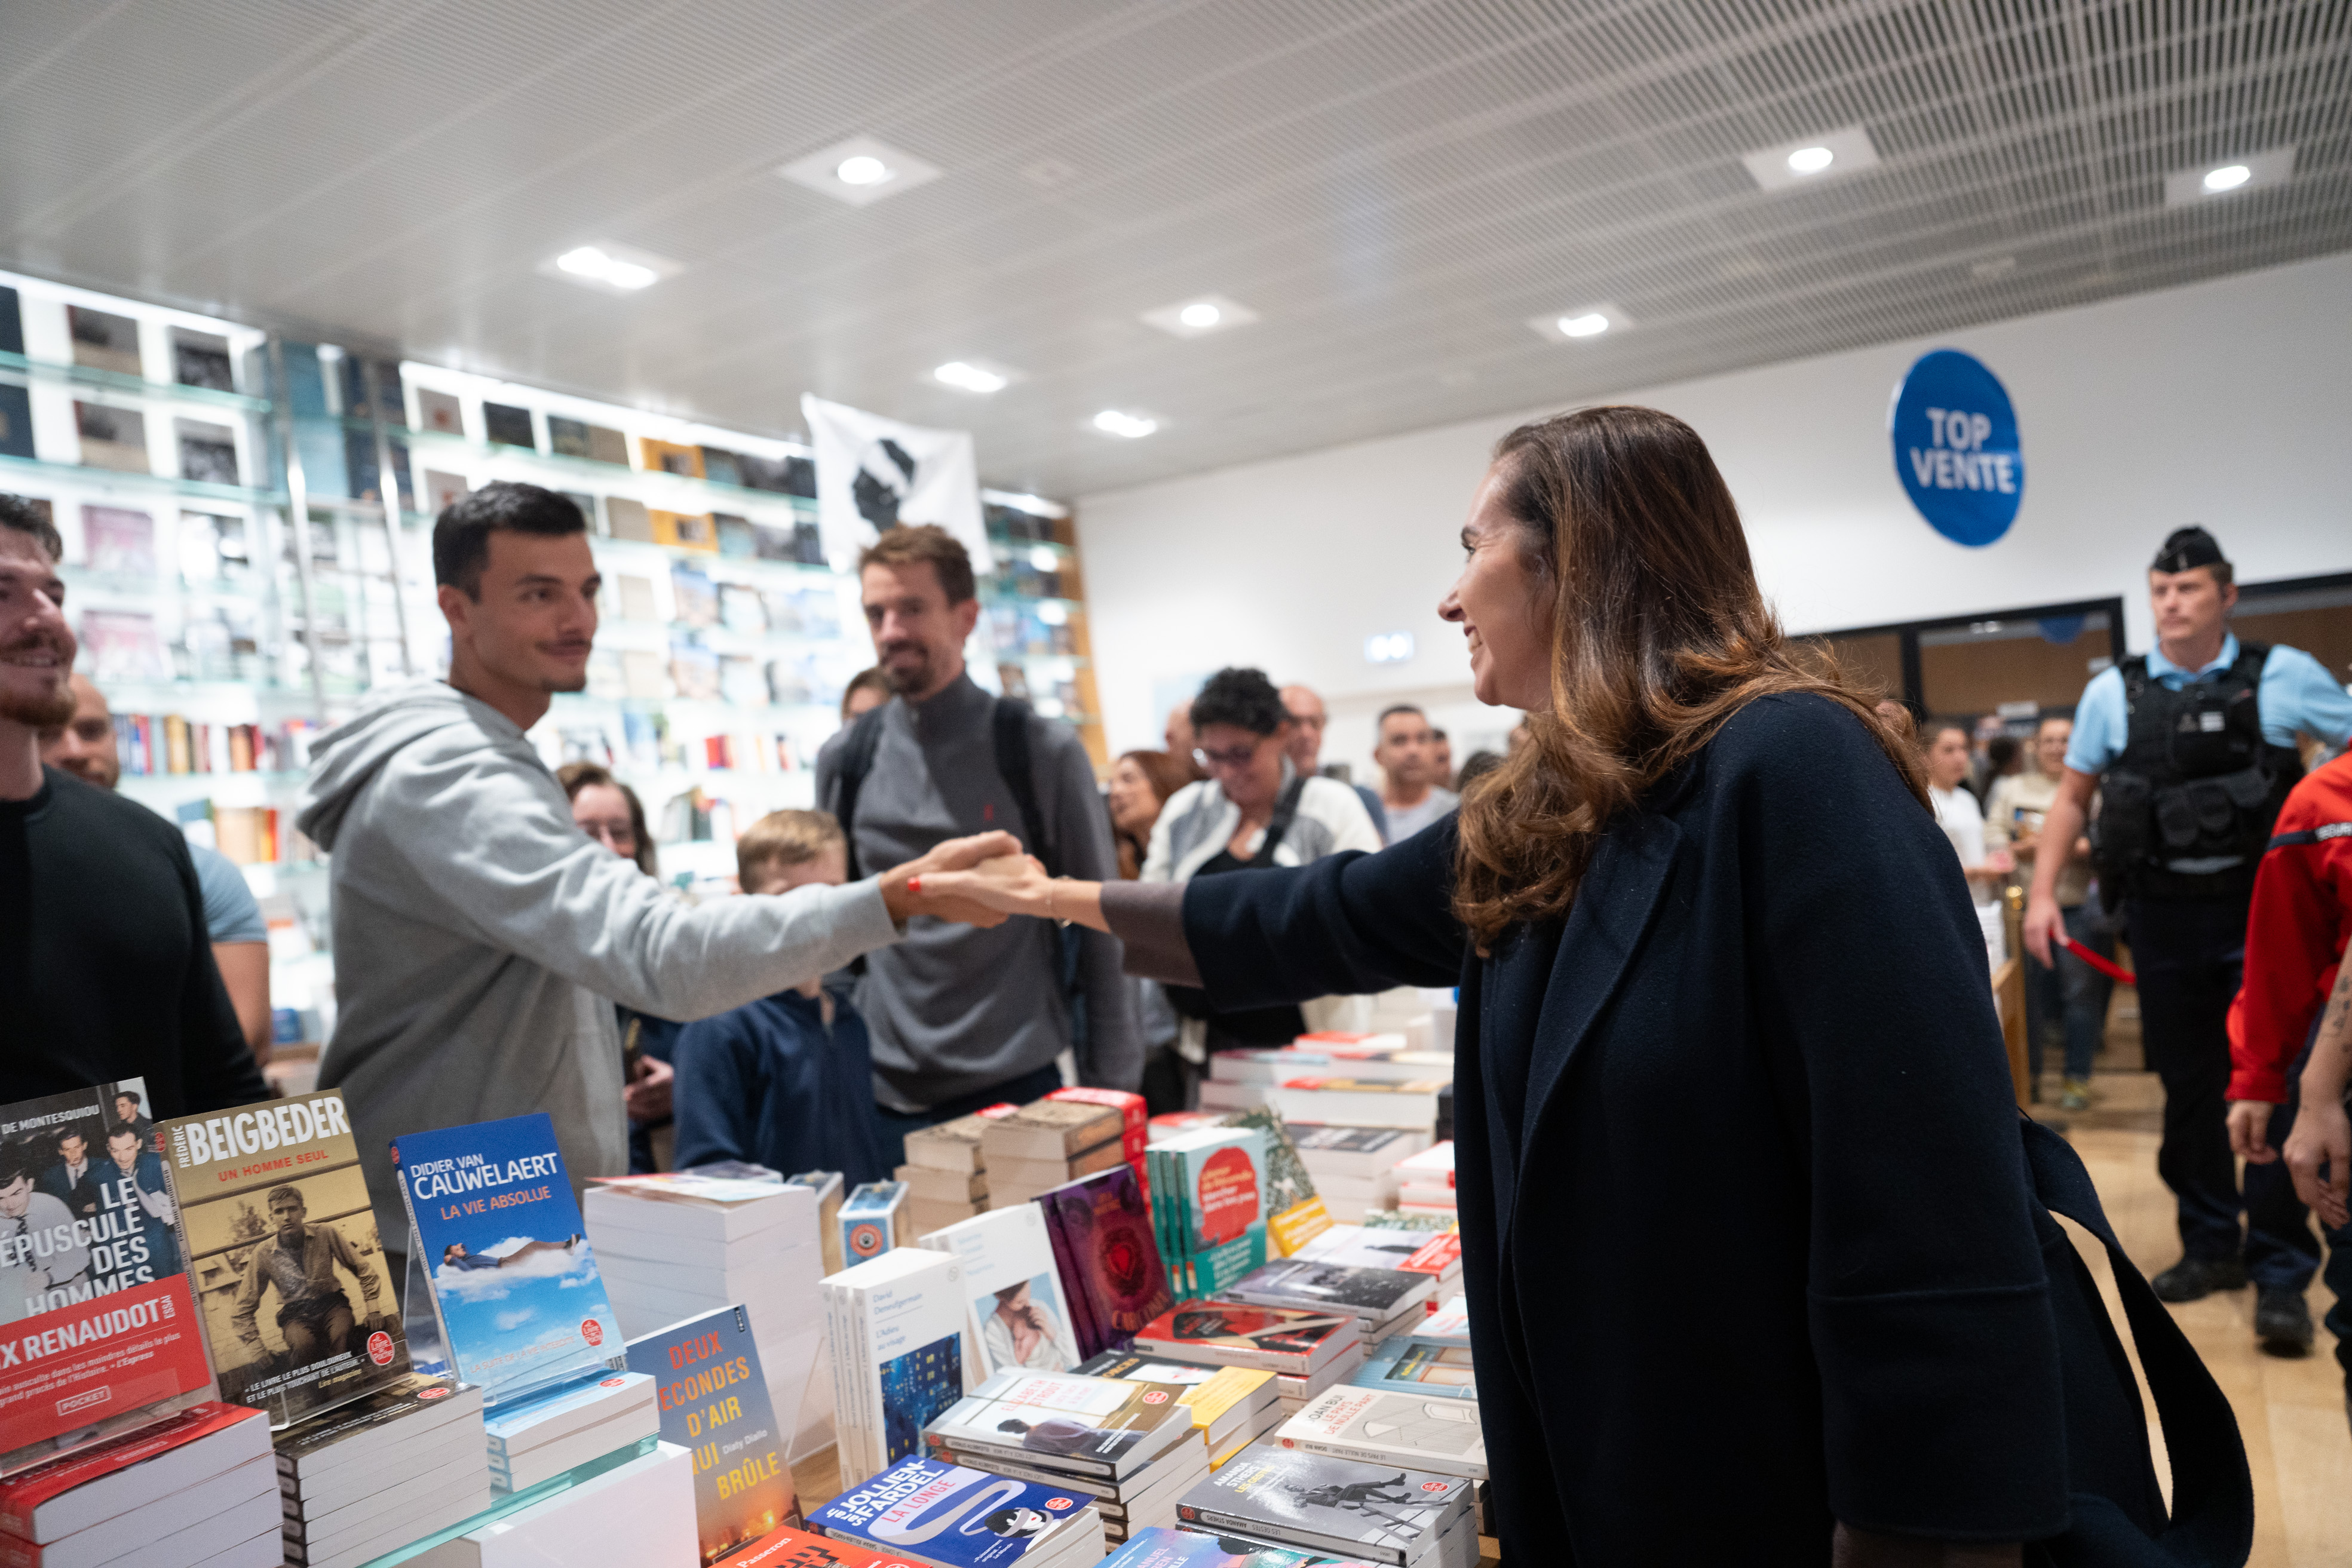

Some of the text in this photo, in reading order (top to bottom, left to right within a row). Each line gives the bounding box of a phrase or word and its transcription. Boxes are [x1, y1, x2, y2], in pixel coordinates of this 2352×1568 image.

[1925, 407, 1992, 452] TOP
[1910, 447, 2017, 495] VENTE
[1, 1104, 100, 1134] DE MONTESQUIOU
[185, 1096, 351, 1166] BEIGBEDER
[171, 1125, 192, 1168] FRÉDÉRIC
[218, 1149, 329, 1182] UN HOMME SEUL
[410, 1153, 484, 1178] DIDIER VAN
[414, 1152, 557, 1199] CAUWELAERT
[100, 1176, 138, 1210] LE
[440, 1186, 551, 1220] LA VIE ABSOLUE
[0, 1205, 144, 1268] ÉPUSCULE
[91, 1235, 150, 1275] DES
[26, 1266, 155, 1317] HOMMES
[160, 1294, 175, 1319] ESSAI
[23, 1299, 160, 1361] RENAUDOT
[163, 1332, 181, 1345] plus
[470, 1364, 481, 1373] LA
[482, 1357, 504, 1370] SUITE
[505, 1354, 515, 1362] DE
[669, 1331, 723, 1370] DEUX
[246, 1395, 256, 1404] ET
[257, 1391, 266, 1400] LE
[321, 1369, 330, 1378] DE
[250, 1383, 259, 1392] LE
[260, 1375, 282, 1388] LIVRE
[282, 1372, 292, 1382] LE
[292, 1366, 310, 1379] PLUS
[318, 1368, 362, 1389] Lire magazine
[658, 1357, 750, 1412] ECONDES
[1028, 1382, 1063, 1407] STROUT
[62, 1390, 105, 1411] POCKET
[1001, 1380, 1047, 1411] ELIZABETH
[1321, 1401, 1353, 1422] LE PAYS
[1326, 1395, 1345, 1405] BUI
[687, 1396, 742, 1437] D'AIR
[1324, 1394, 1376, 1434] DE NULLE PART
[722, 1429, 768, 1455] Diaty Diallo
[716, 1452, 781, 1499] BRÛLE
[839, 1460, 925, 1512] JOLLIEN-
[1213, 1462, 1252, 1487] AMANDA
[1226, 1465, 1261, 1487] STHERS
[1234, 1481, 1252, 1493] LES
[855, 1469, 945, 1518] FARDEL
[881, 1480, 956, 1523] LA LONGE
[826, 1508, 868, 1527] Sarah
[1207, 1514, 1223, 1524] STHERS
[1224, 1517, 1247, 1528] AMANDA
[736, 1537, 792, 1568] Passeron
